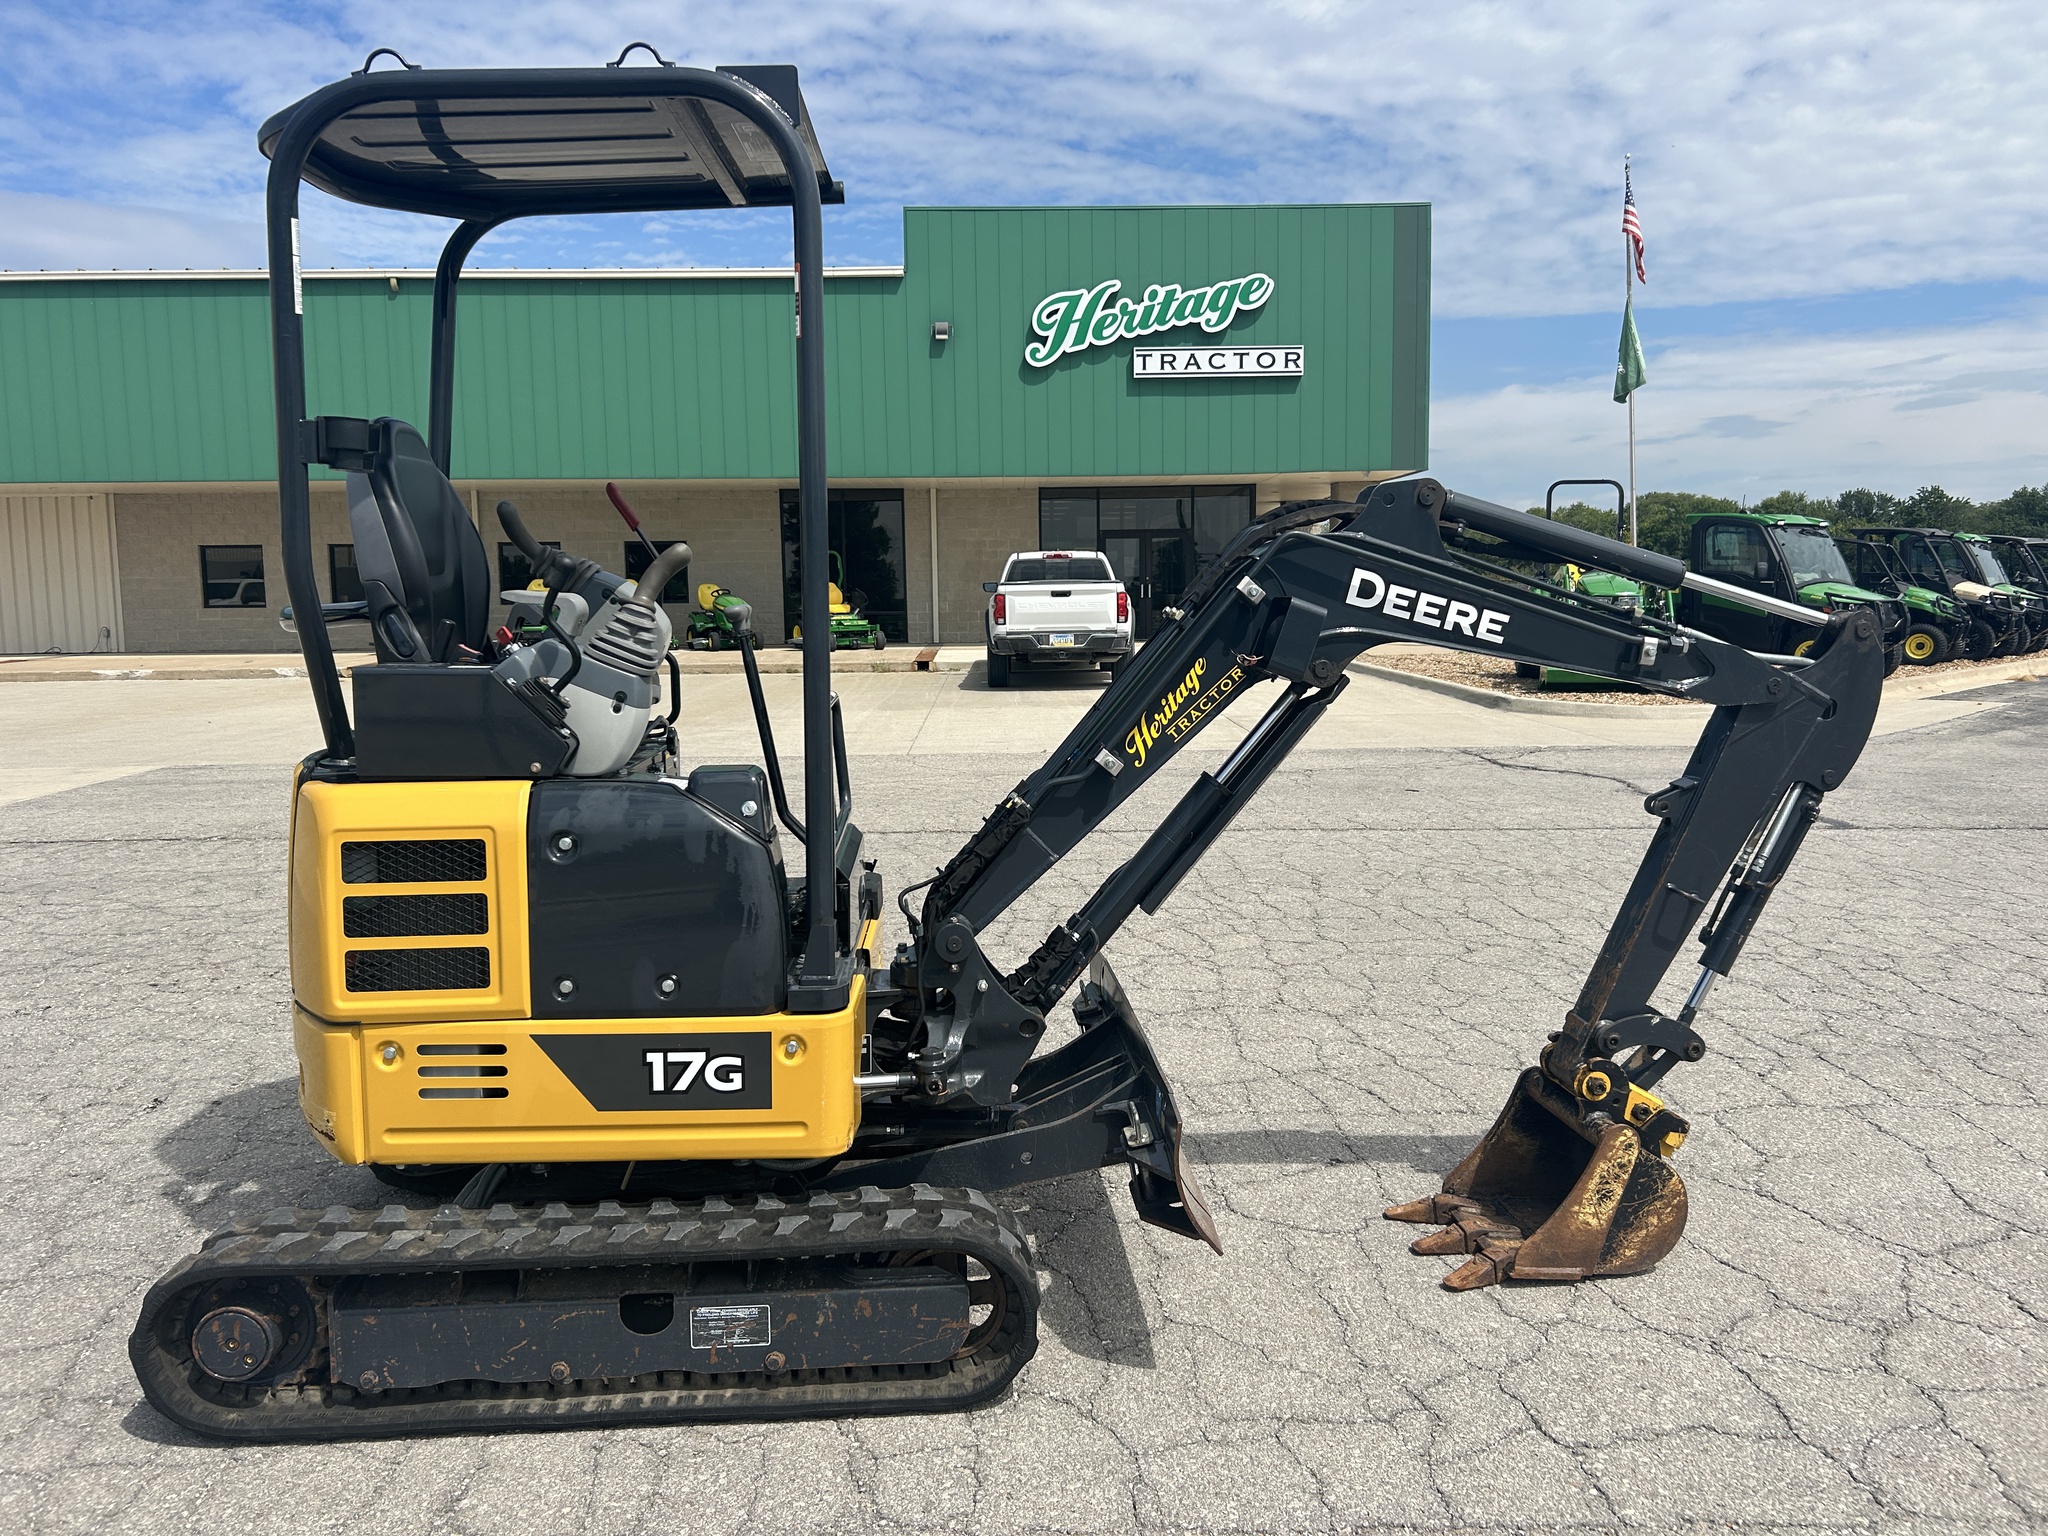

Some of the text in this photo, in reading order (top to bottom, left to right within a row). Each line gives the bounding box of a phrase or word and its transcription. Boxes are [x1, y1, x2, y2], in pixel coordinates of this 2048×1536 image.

[1026, 273, 1274, 366] Heritage
[1136, 351, 1301, 371] TRACTOR
[1017, 601, 1106, 610] CHEVROLET
[1345, 567, 1511, 644] DEERE
[1125, 657, 1207, 768] Heritage
[1167, 667, 1245, 739] TRACTOR
[645, 1050, 743, 1092] 17G
